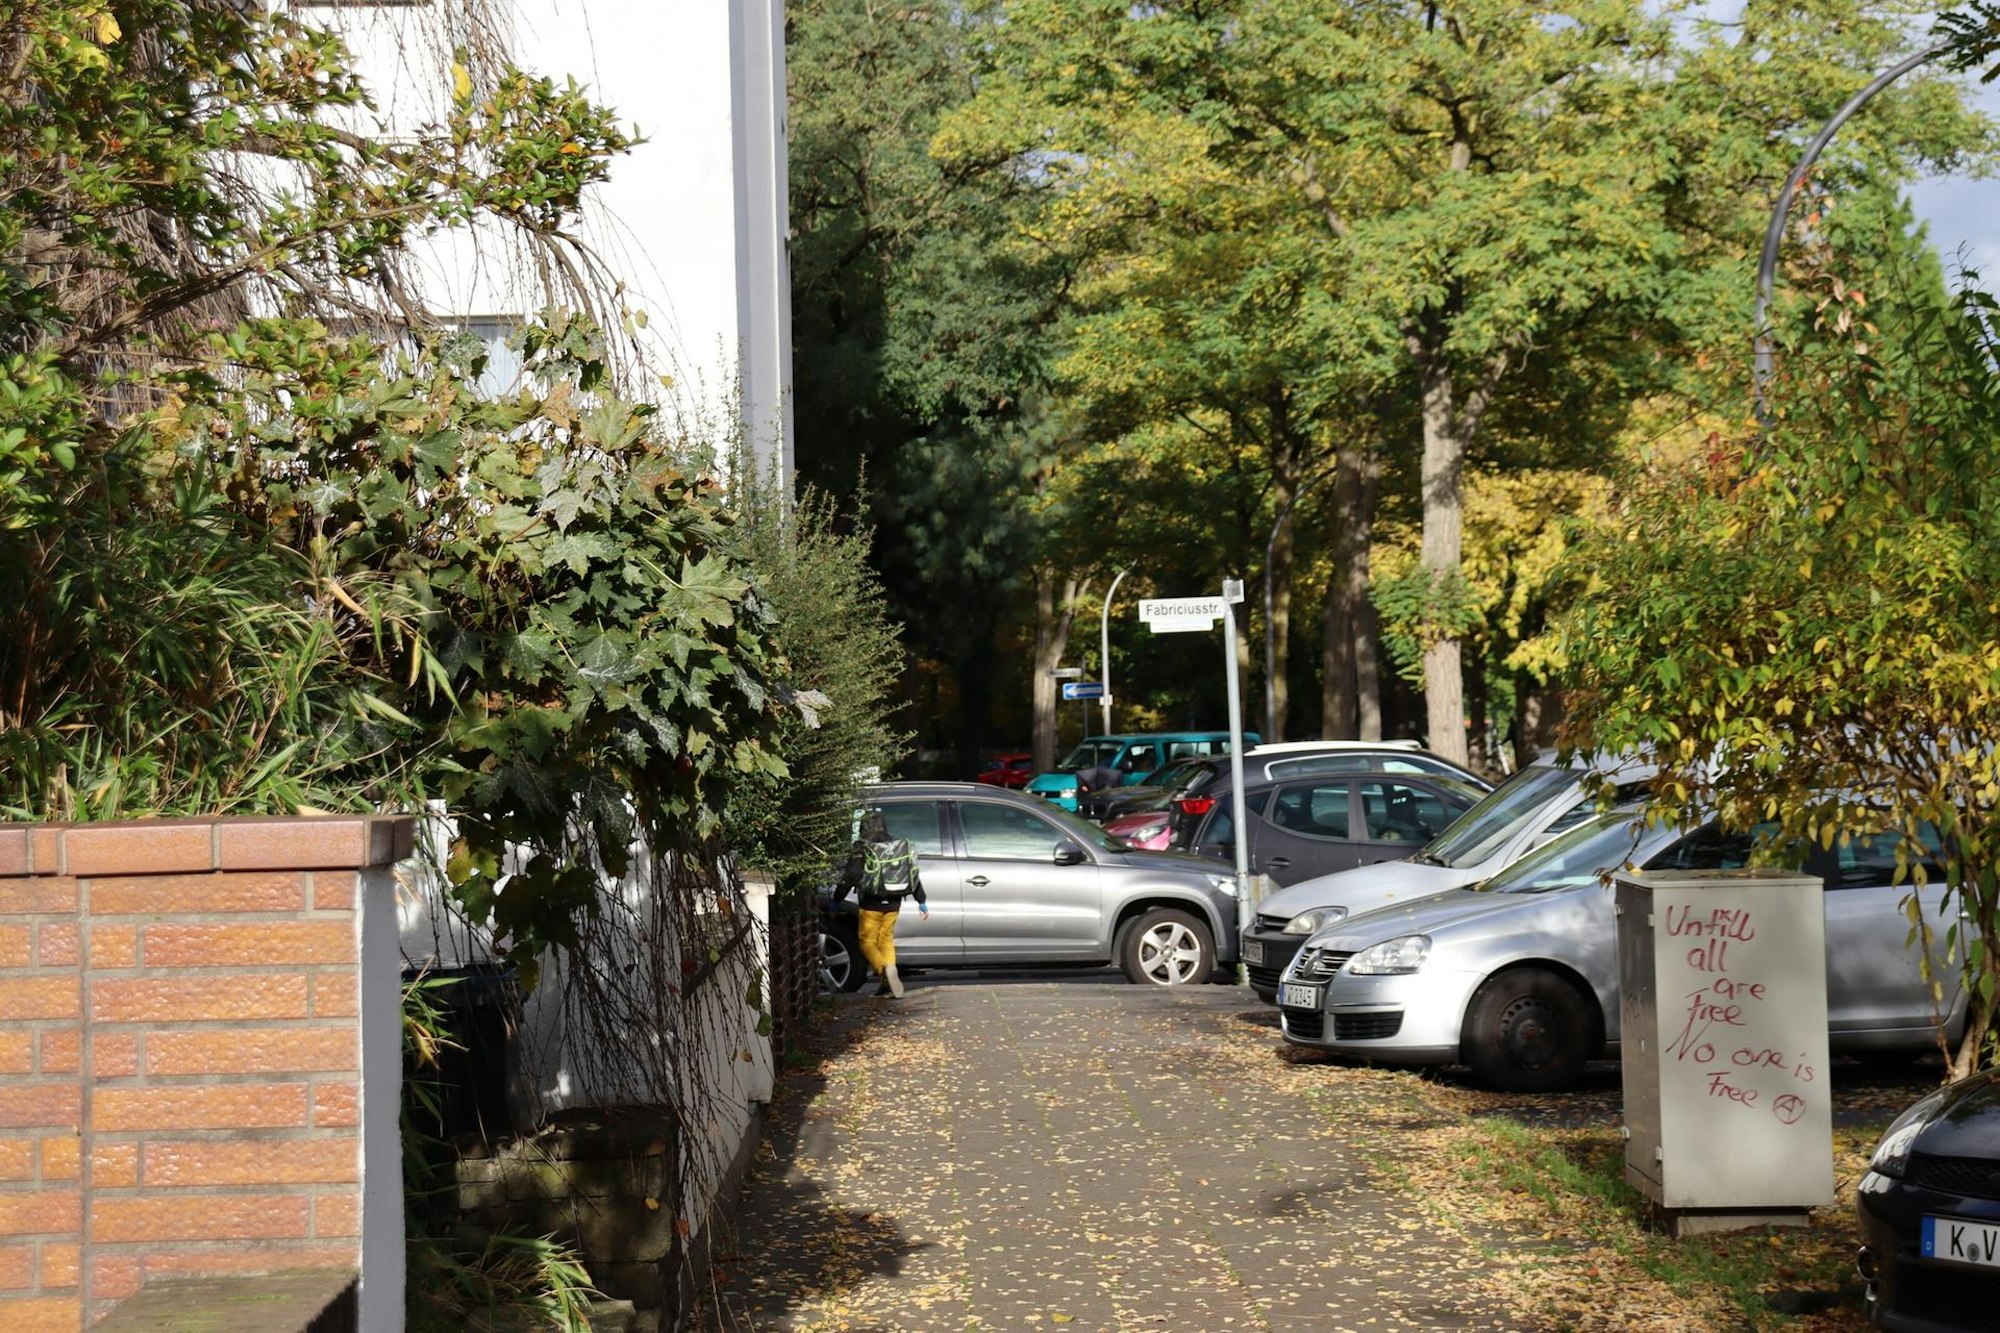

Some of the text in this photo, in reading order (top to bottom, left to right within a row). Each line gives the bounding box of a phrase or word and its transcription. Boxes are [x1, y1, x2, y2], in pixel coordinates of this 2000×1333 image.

[1687, 938, 1728, 972] all
[1713, 978, 1766, 1000] are
[1666, 1012, 1814, 1081] No one is
[1707, 1072, 1758, 1109] Free
